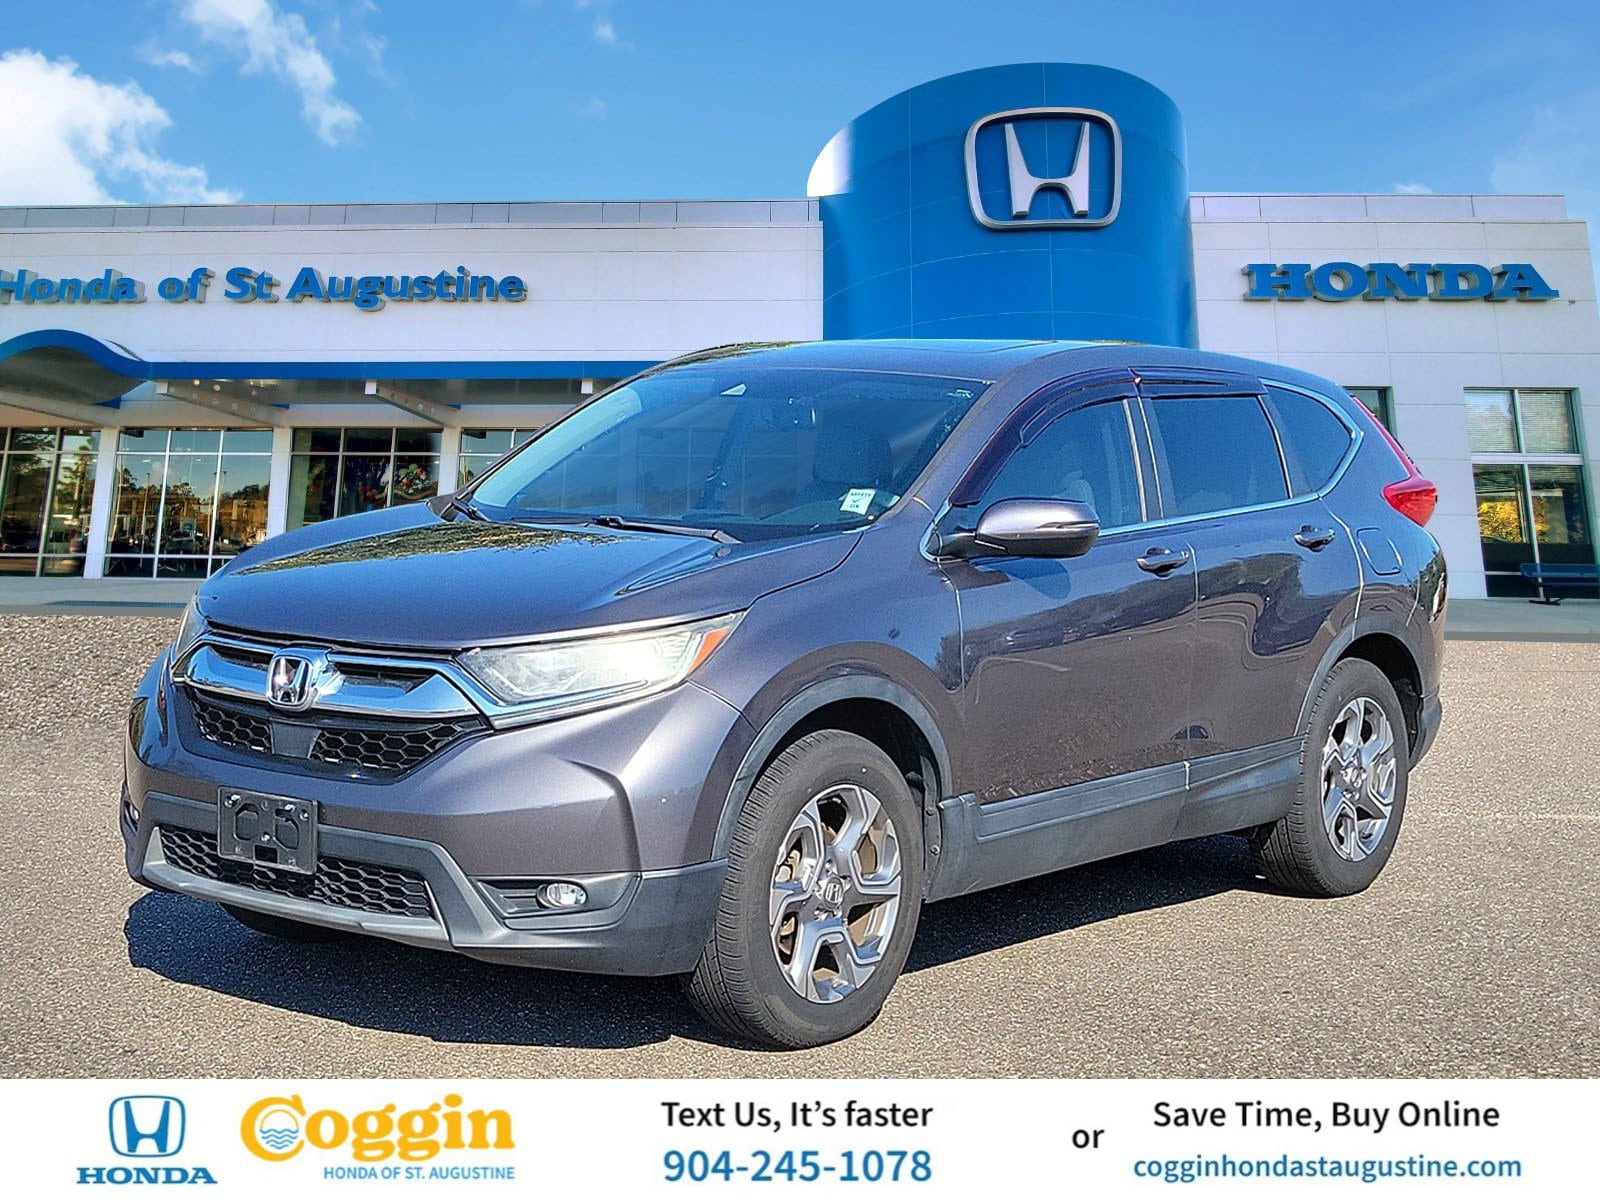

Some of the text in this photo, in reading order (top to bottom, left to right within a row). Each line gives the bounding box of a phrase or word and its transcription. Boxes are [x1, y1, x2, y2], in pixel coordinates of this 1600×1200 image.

[0, 265, 528, 312] Honda of St Augustine
[1241, 261, 1560, 302] HONDA
